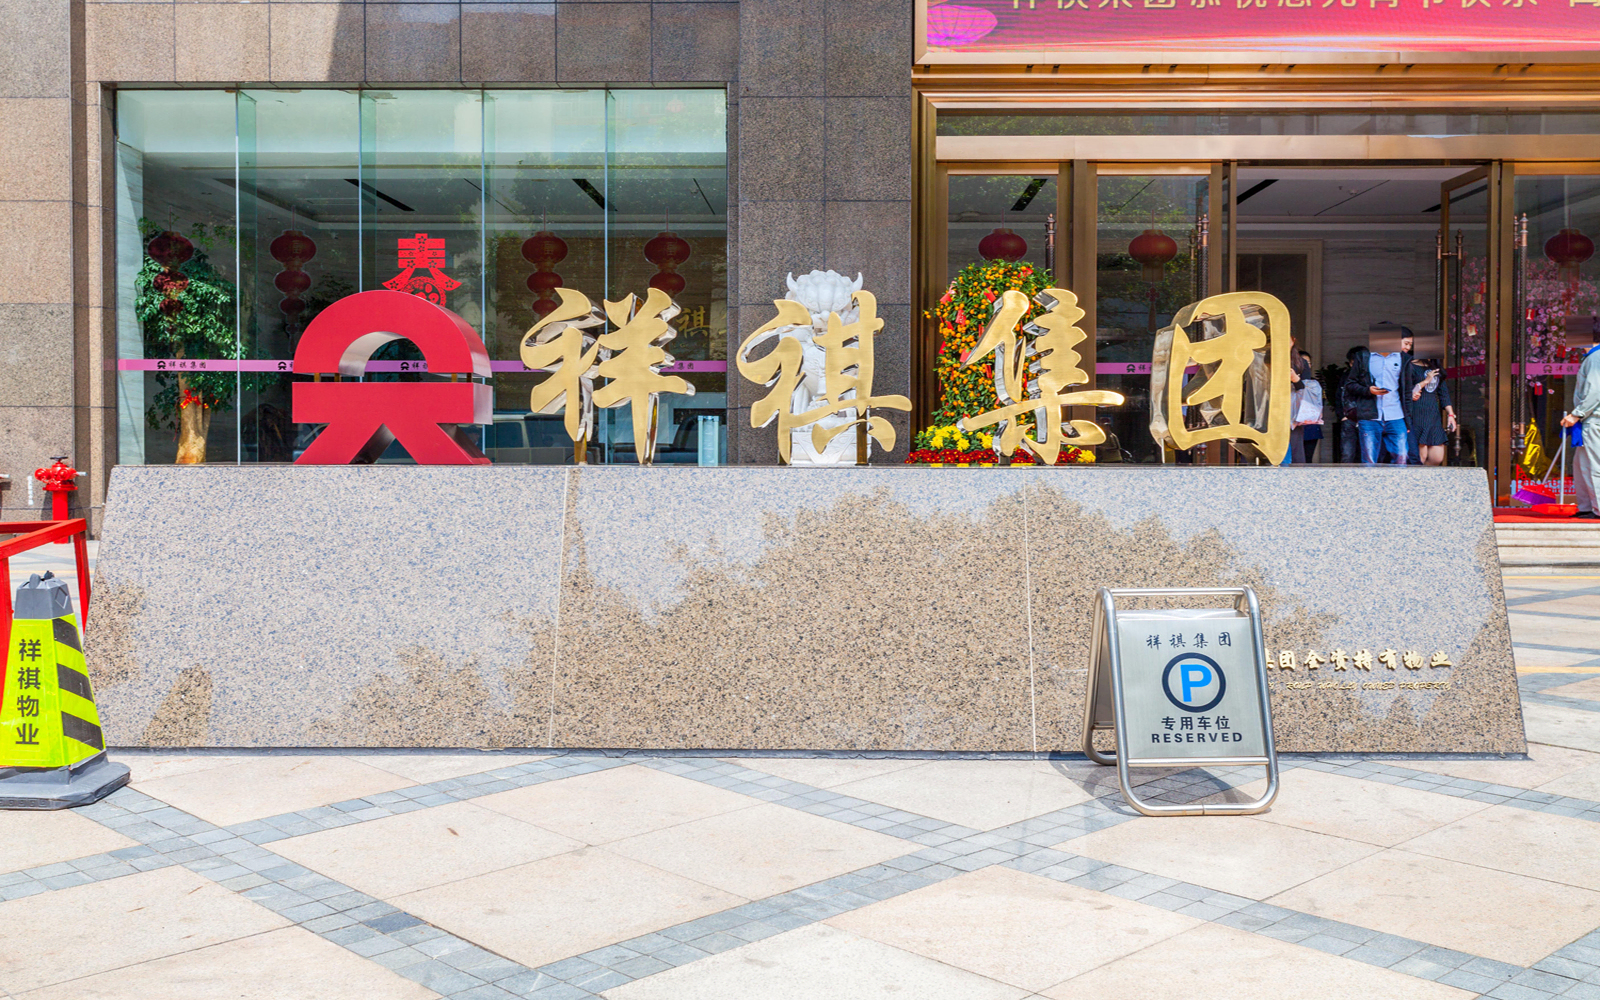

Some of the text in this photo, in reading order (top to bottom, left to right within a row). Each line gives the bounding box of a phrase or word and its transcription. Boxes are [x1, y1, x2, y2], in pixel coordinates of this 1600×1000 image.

[676, 305, 727, 338] 祺
[520, 285, 1292, 465] 祥祺集团
[1146, 631, 1232, 650] 祥祺集团
[15, 638, 42, 746] 祥祺物业
[1180, 664, 1212, 702] P
[1151, 732, 1243, 744] RESERVED
[1161, 715, 1231, 731] 专用车位
